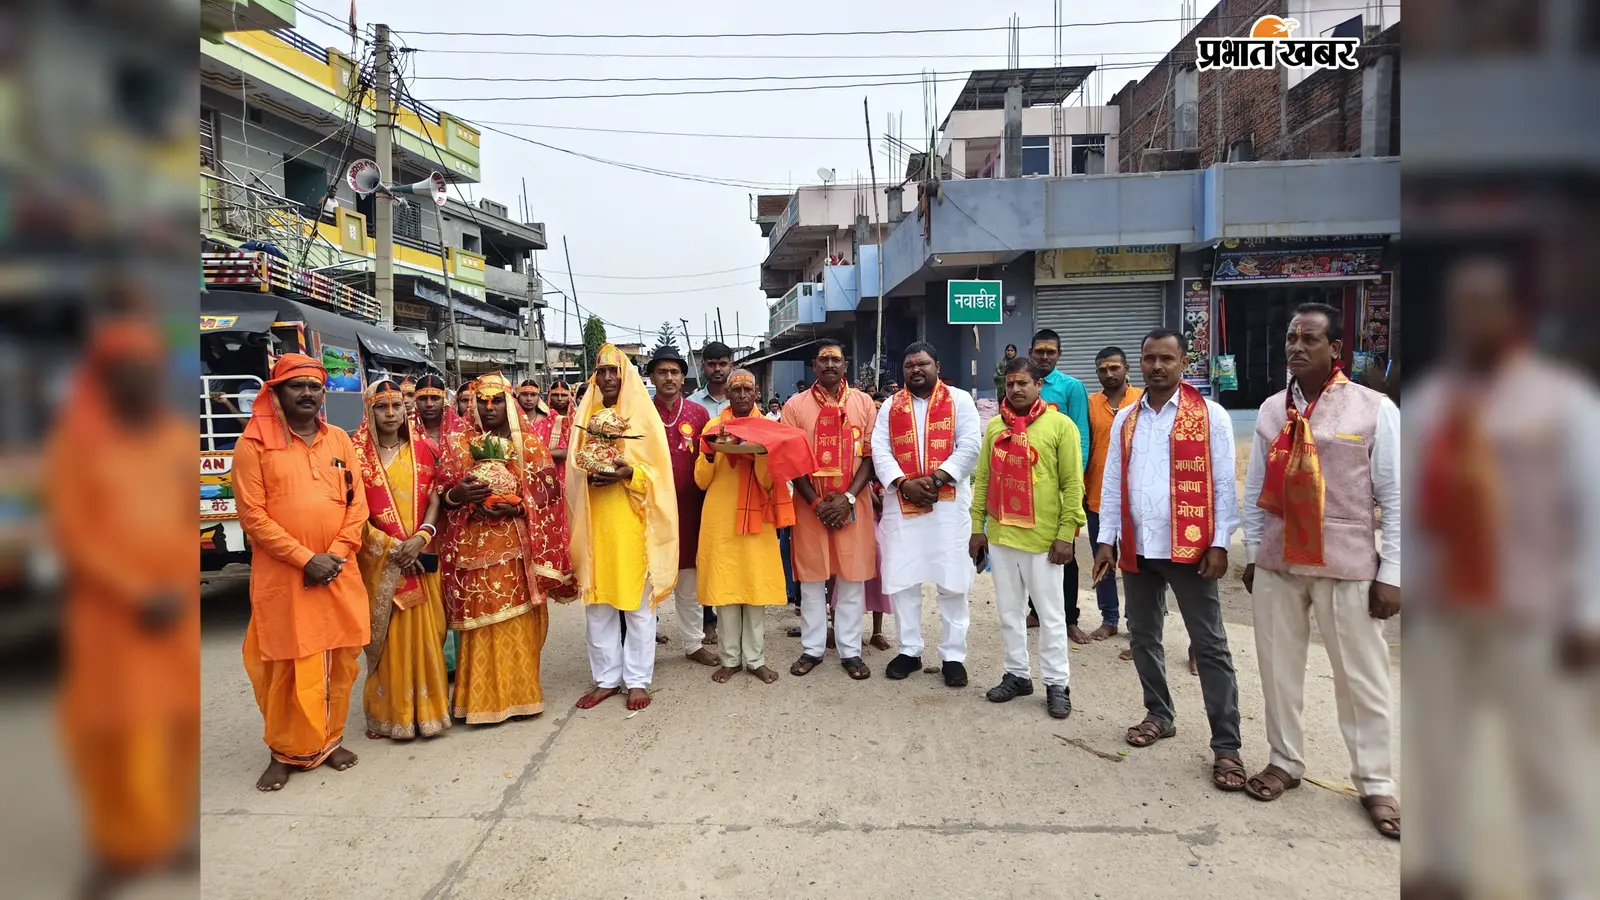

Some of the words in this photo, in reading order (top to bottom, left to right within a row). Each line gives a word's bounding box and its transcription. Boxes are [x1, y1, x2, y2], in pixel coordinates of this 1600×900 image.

[954, 288, 997, 310] नवाडीह
[200, 458, 225, 471] AN
[1175, 456, 1206, 472] गणपति
[1177, 480, 1203, 493] बाप्पा
[1177, 501, 1206, 518] मोरया
